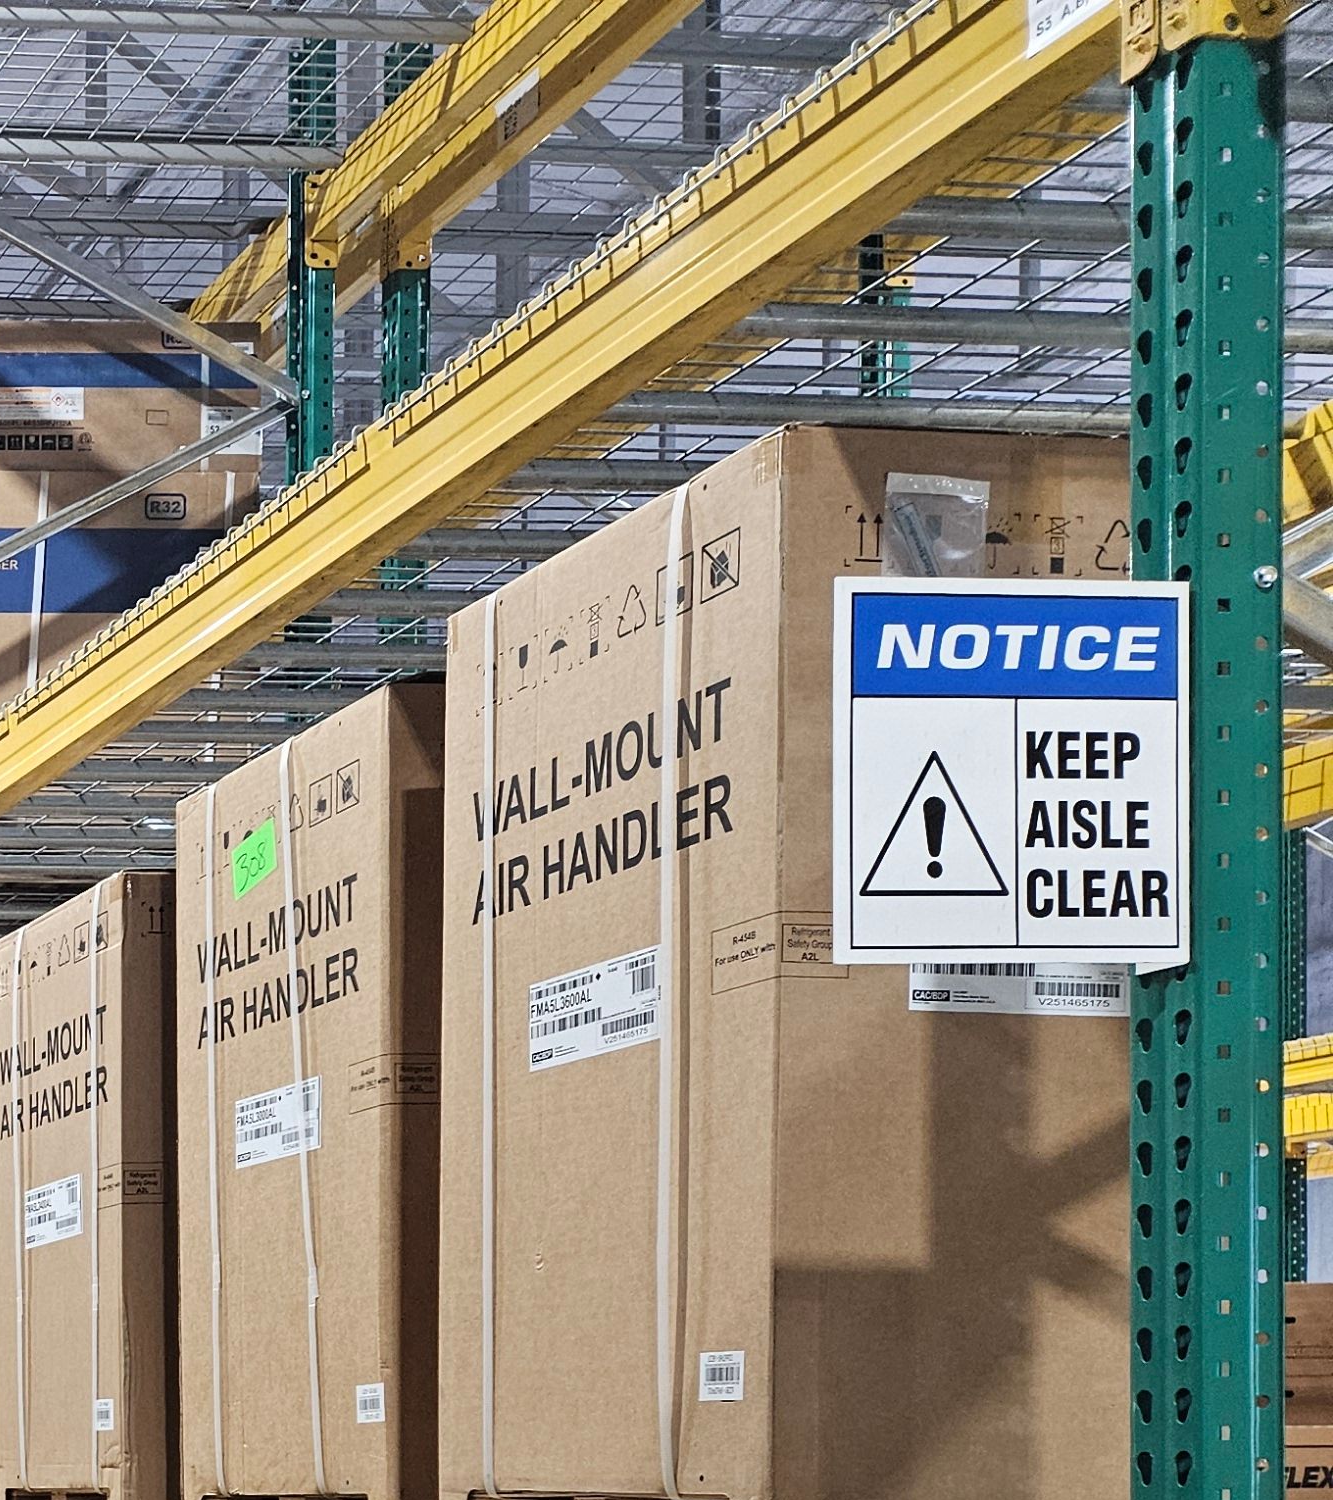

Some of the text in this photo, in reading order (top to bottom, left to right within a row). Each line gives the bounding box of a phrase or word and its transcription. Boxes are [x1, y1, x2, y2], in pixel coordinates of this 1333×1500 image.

[1036, 14, 1052, 37] S3
[149, 499, 182, 514] R32
[876, 624, 1162, 671] NOTICE
[472, 676, 733, 843] WALL-MOUNT
[1025, 731, 1143, 781] KEEP
[471, 772, 733, 926] AIR HANDLER
[1025, 800, 1151, 850] AISLE
[235, 841, 267, 893] 308
[1025, 867, 1170, 919] CLEAR
[197, 872, 358, 984] WALL-MOUNT
[787, 939, 833, 951] Safety Group
[791, 926, 831, 938] Refrigerant
[714, 957, 727, 967] For
[740, 947, 760, 960] ONLY
[801, 952, 819, 961] A2L
[197, 947, 360, 1050] AIR HANDLER
[530, 988, 593, 1018] FMA5L3600AL
[1037, 997, 1111, 1008] V251465175
[0, 1004, 108, 1086] WALL-MOUNT
[603, 1027, 649, 1045] V251465175
[0, 1064, 109, 1140] AIR HANDLER
